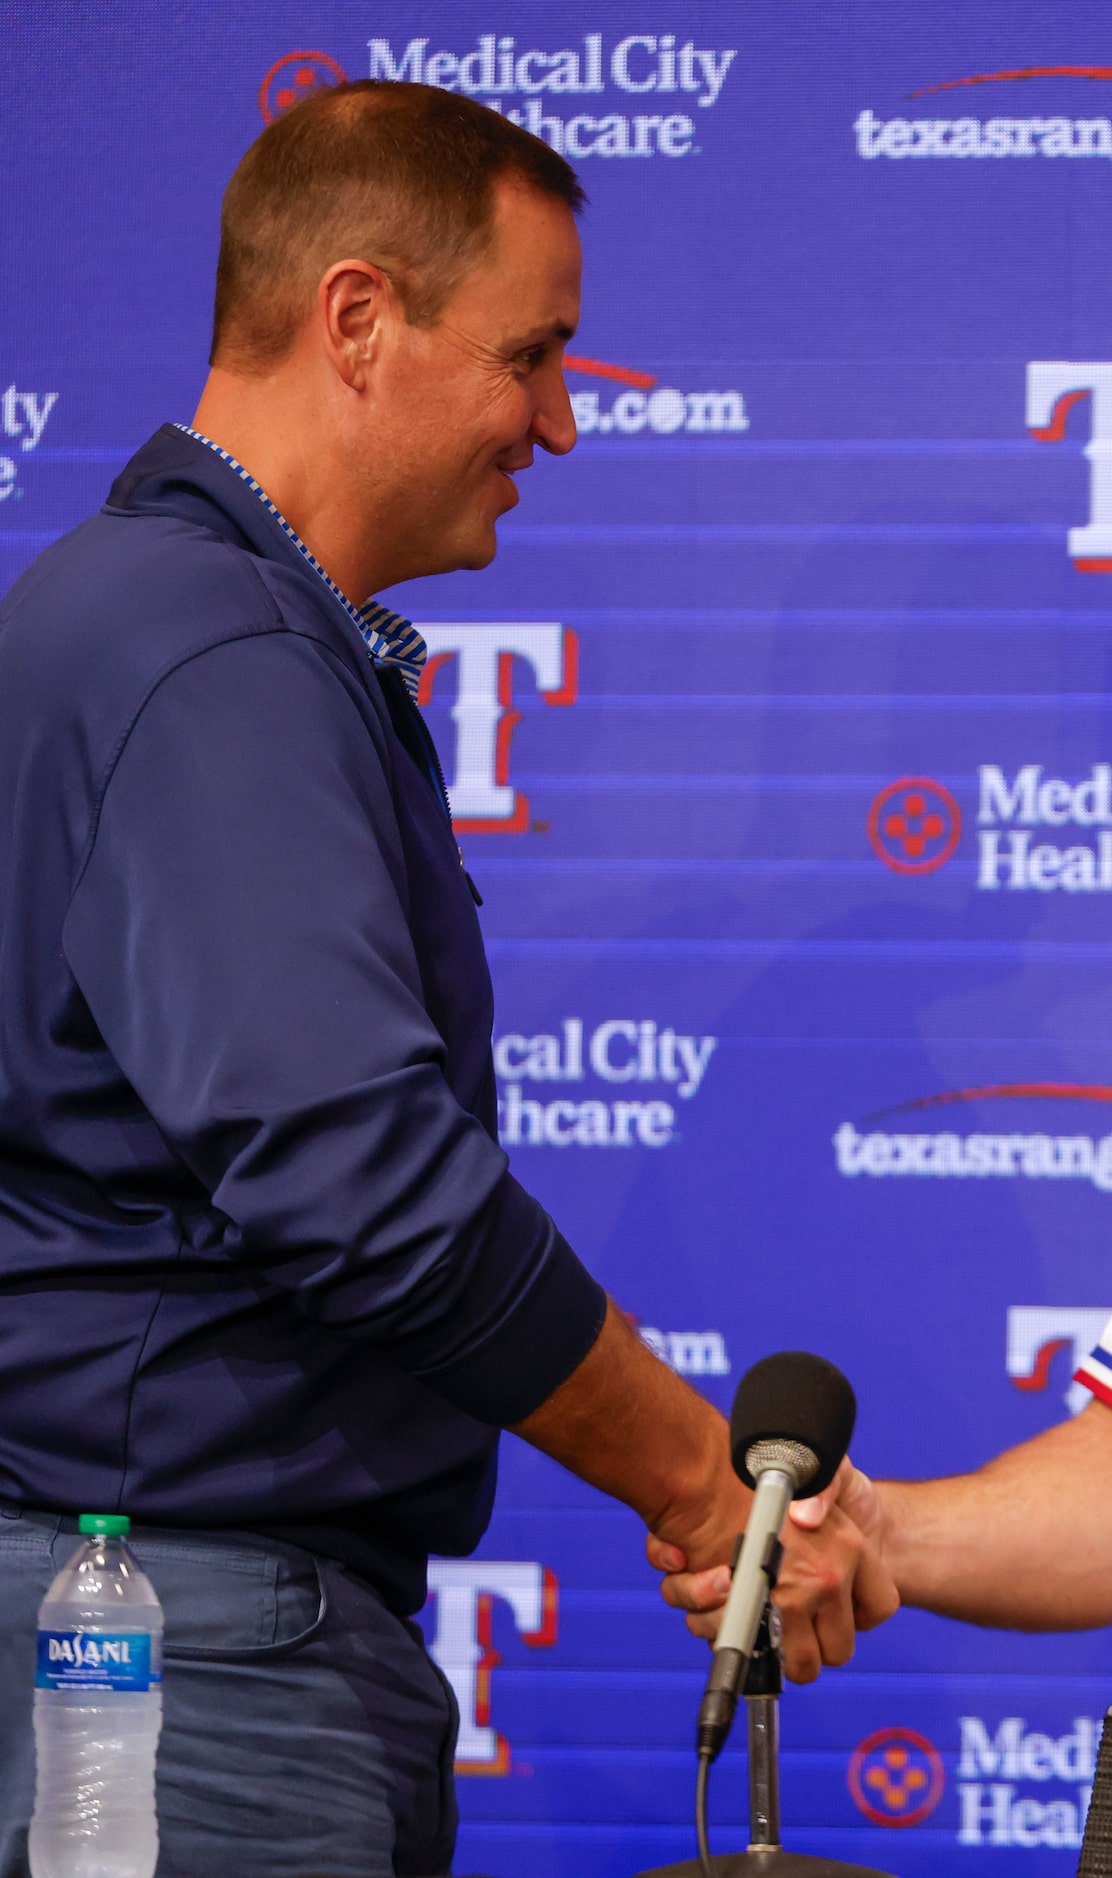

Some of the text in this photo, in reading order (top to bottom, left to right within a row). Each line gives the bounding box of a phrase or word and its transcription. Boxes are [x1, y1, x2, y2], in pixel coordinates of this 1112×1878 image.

[366, 33, 738, 107] Medical City
[413, 622, 579, 834] T
[590, 1020, 718, 1099] City
[48, 1633, 132, 1668] DASANI
[958, 1716, 1104, 1782] Med
